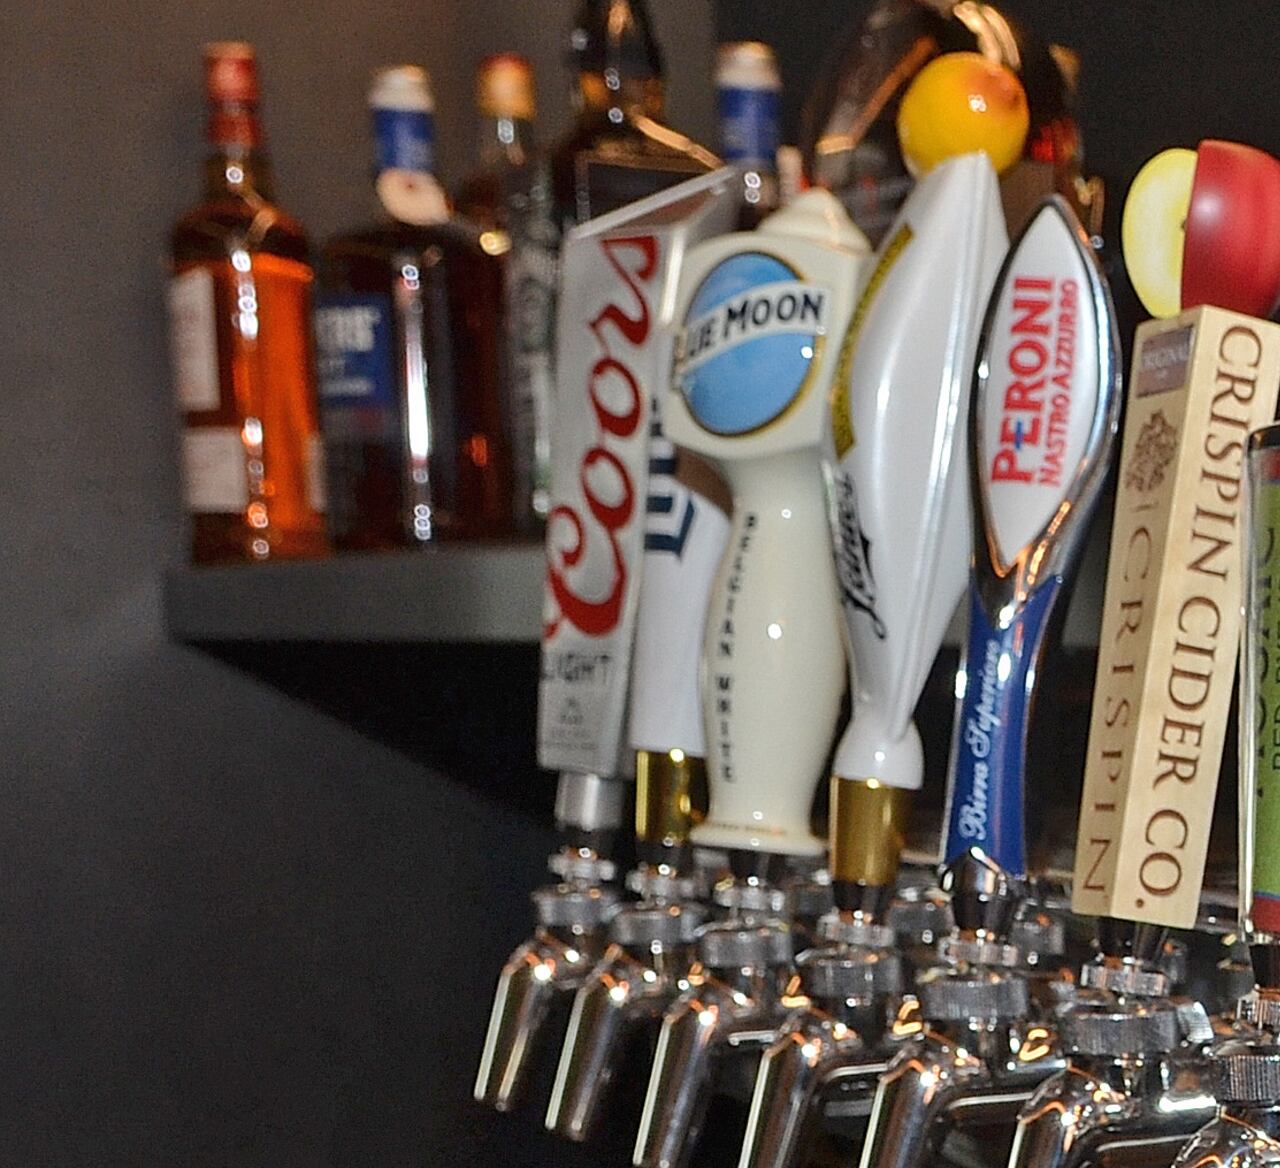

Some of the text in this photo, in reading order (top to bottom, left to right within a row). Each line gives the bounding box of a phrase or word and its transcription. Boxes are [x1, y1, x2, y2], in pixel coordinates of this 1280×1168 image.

[543, 235, 660, 643] Coors
[724, 293, 824, 339] MOON
[992, 277, 1053, 482] PERONI
[1039, 278, 1079, 487] NASTRO AZZURRO
[1083, 525, 1152, 892] CRISPIN
[1134, 324, 1262, 910] CRISPIN CIDER CO.
